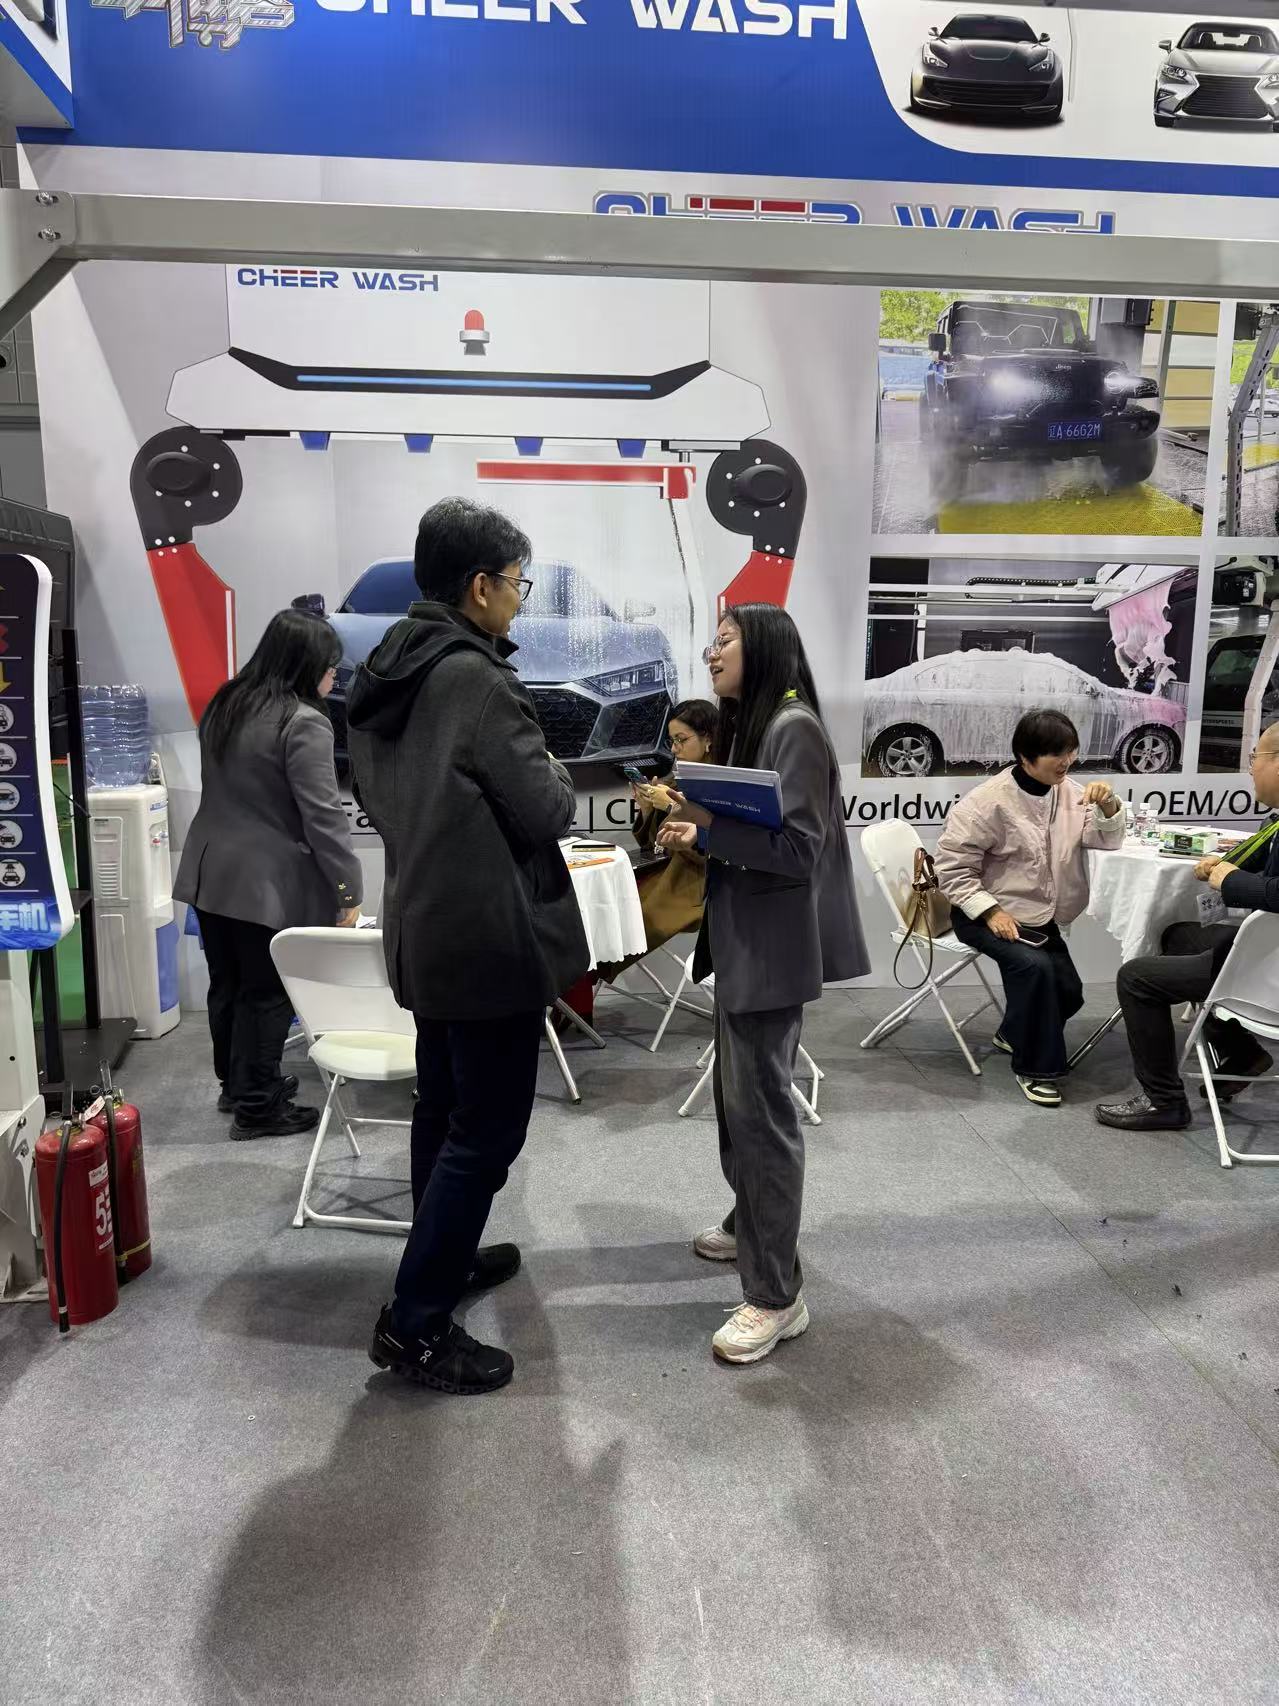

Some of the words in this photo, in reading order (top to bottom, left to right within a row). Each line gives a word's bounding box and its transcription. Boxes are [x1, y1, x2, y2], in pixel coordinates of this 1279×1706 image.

[628, 0, 848, 40] WASH
[237, 267, 339, 289] CHEER
[351, 271, 439, 292] WASH
